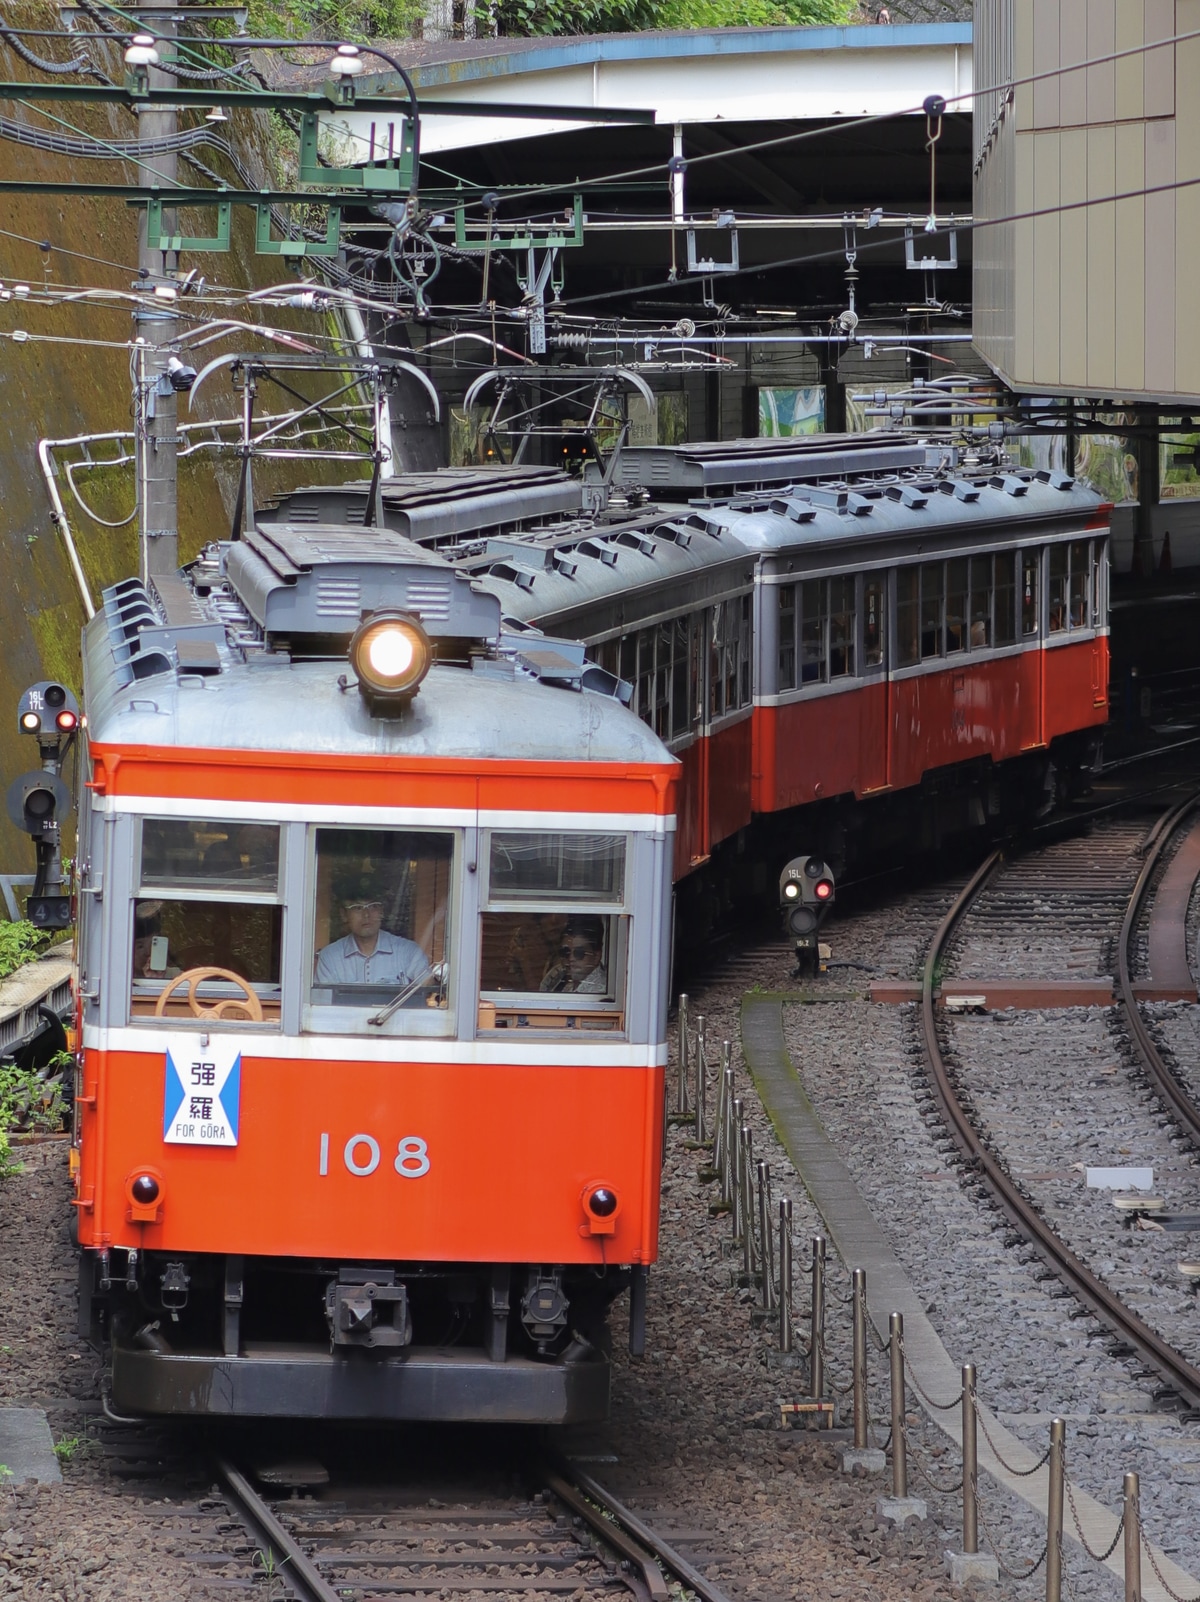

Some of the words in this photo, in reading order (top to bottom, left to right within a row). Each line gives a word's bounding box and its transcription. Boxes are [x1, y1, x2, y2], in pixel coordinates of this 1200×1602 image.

[29, 691, 44, 701] 16L
[29, 700, 44, 710] 17L
[788, 869, 801, 878] 15L
[35, 904, 46, 920] 4
[60, 902, 70, 920] 3
[175, 1123, 196, 1138] FOR
[319, 1132, 431, 1179] 108
